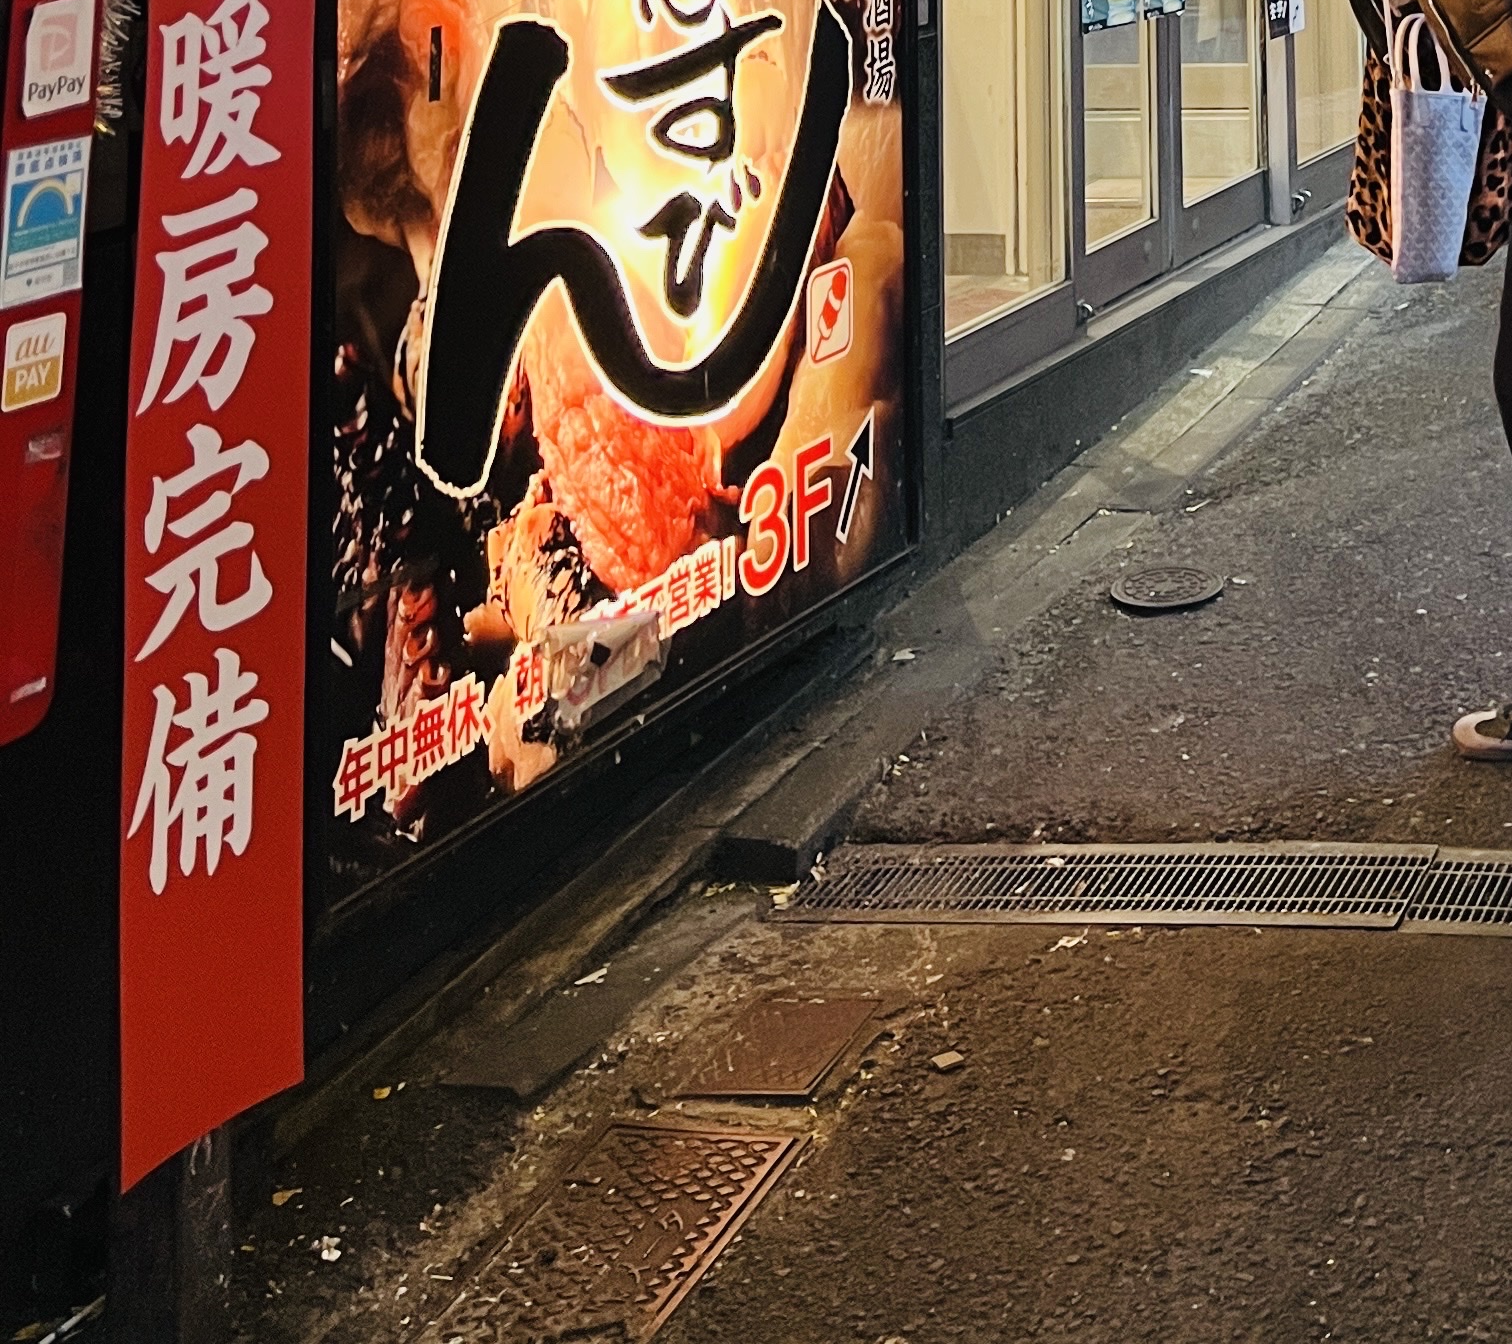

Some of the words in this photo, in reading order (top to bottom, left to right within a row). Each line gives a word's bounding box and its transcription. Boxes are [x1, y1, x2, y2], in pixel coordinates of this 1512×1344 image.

[28, 75, 87, 103] PayPay
[15, 331, 55, 361] au
[15, 361, 52, 394] PAY
[740, 437, 833, 596] 3F
